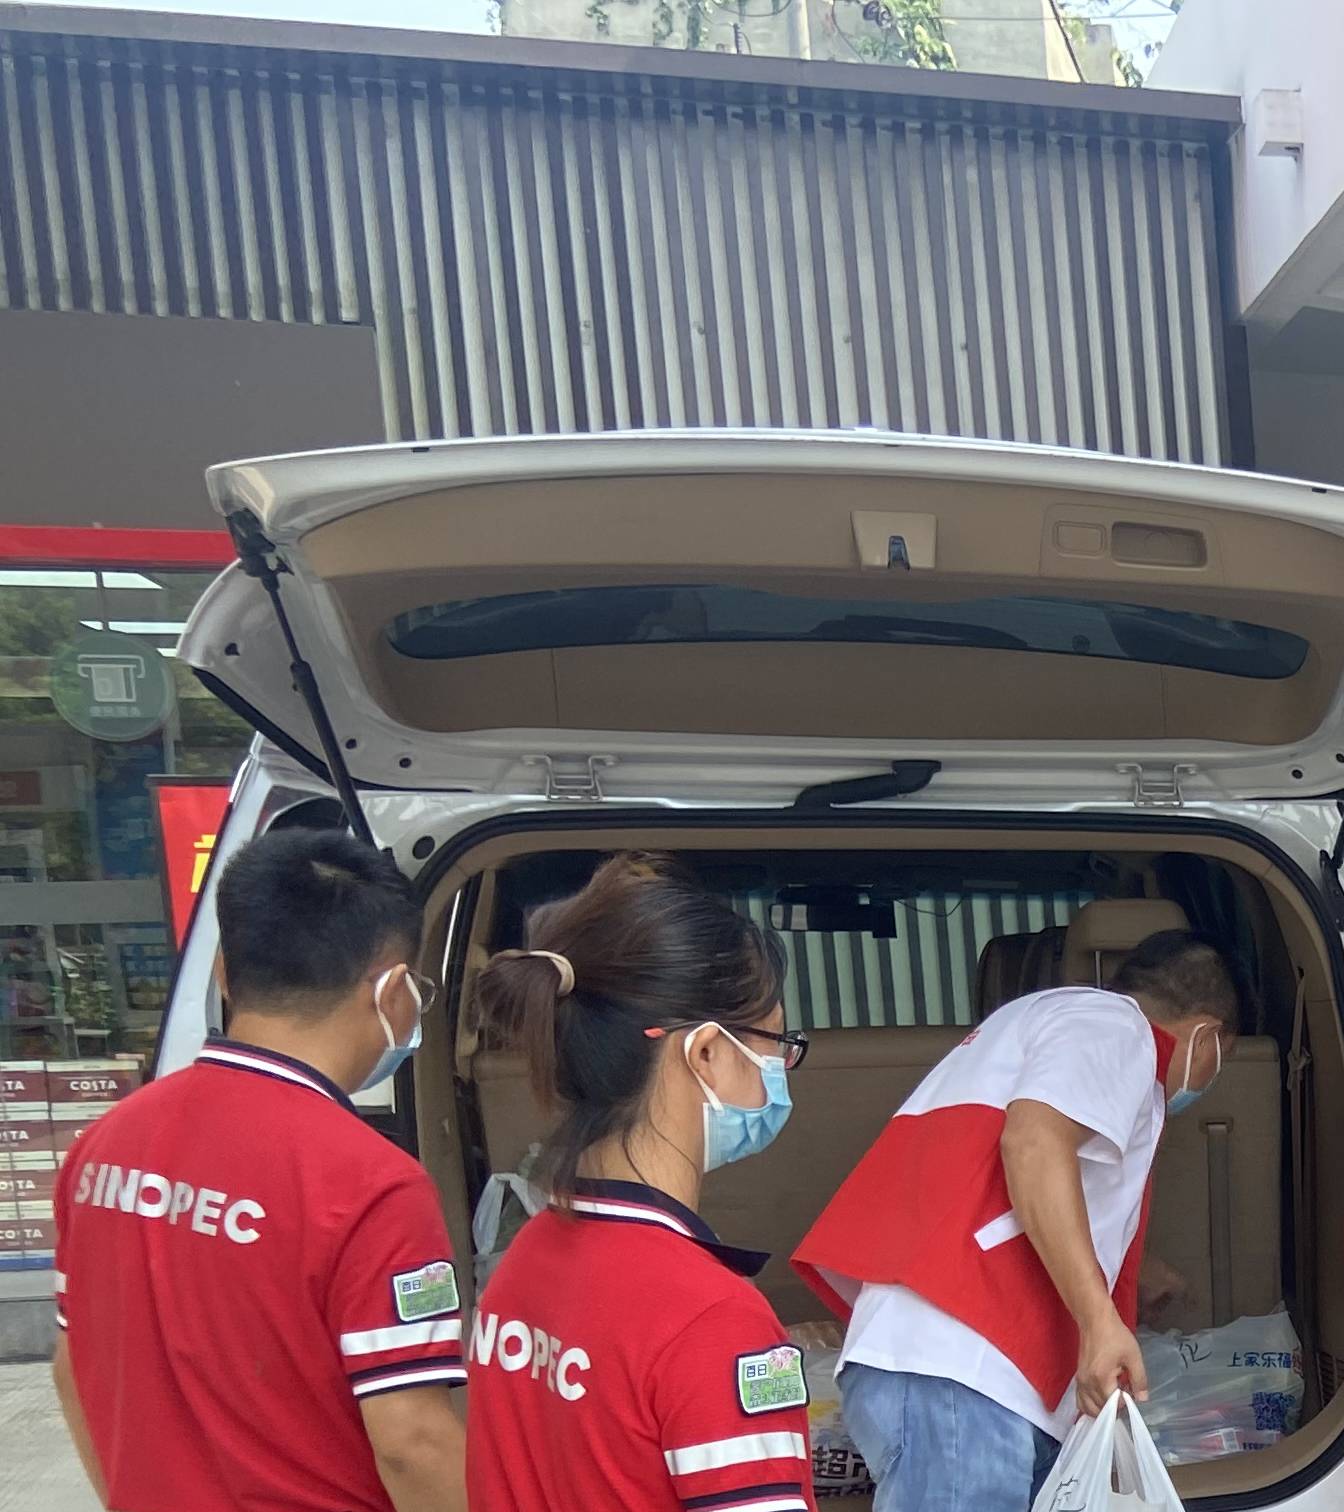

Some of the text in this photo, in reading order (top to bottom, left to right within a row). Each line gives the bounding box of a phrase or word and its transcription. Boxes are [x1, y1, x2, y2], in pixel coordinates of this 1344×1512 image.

[70, 1080, 118, 1091] COSTA
[74, 1162, 266, 1244] SINOPEC
[1227, 1351, 1292, 1368] 上家乐福
